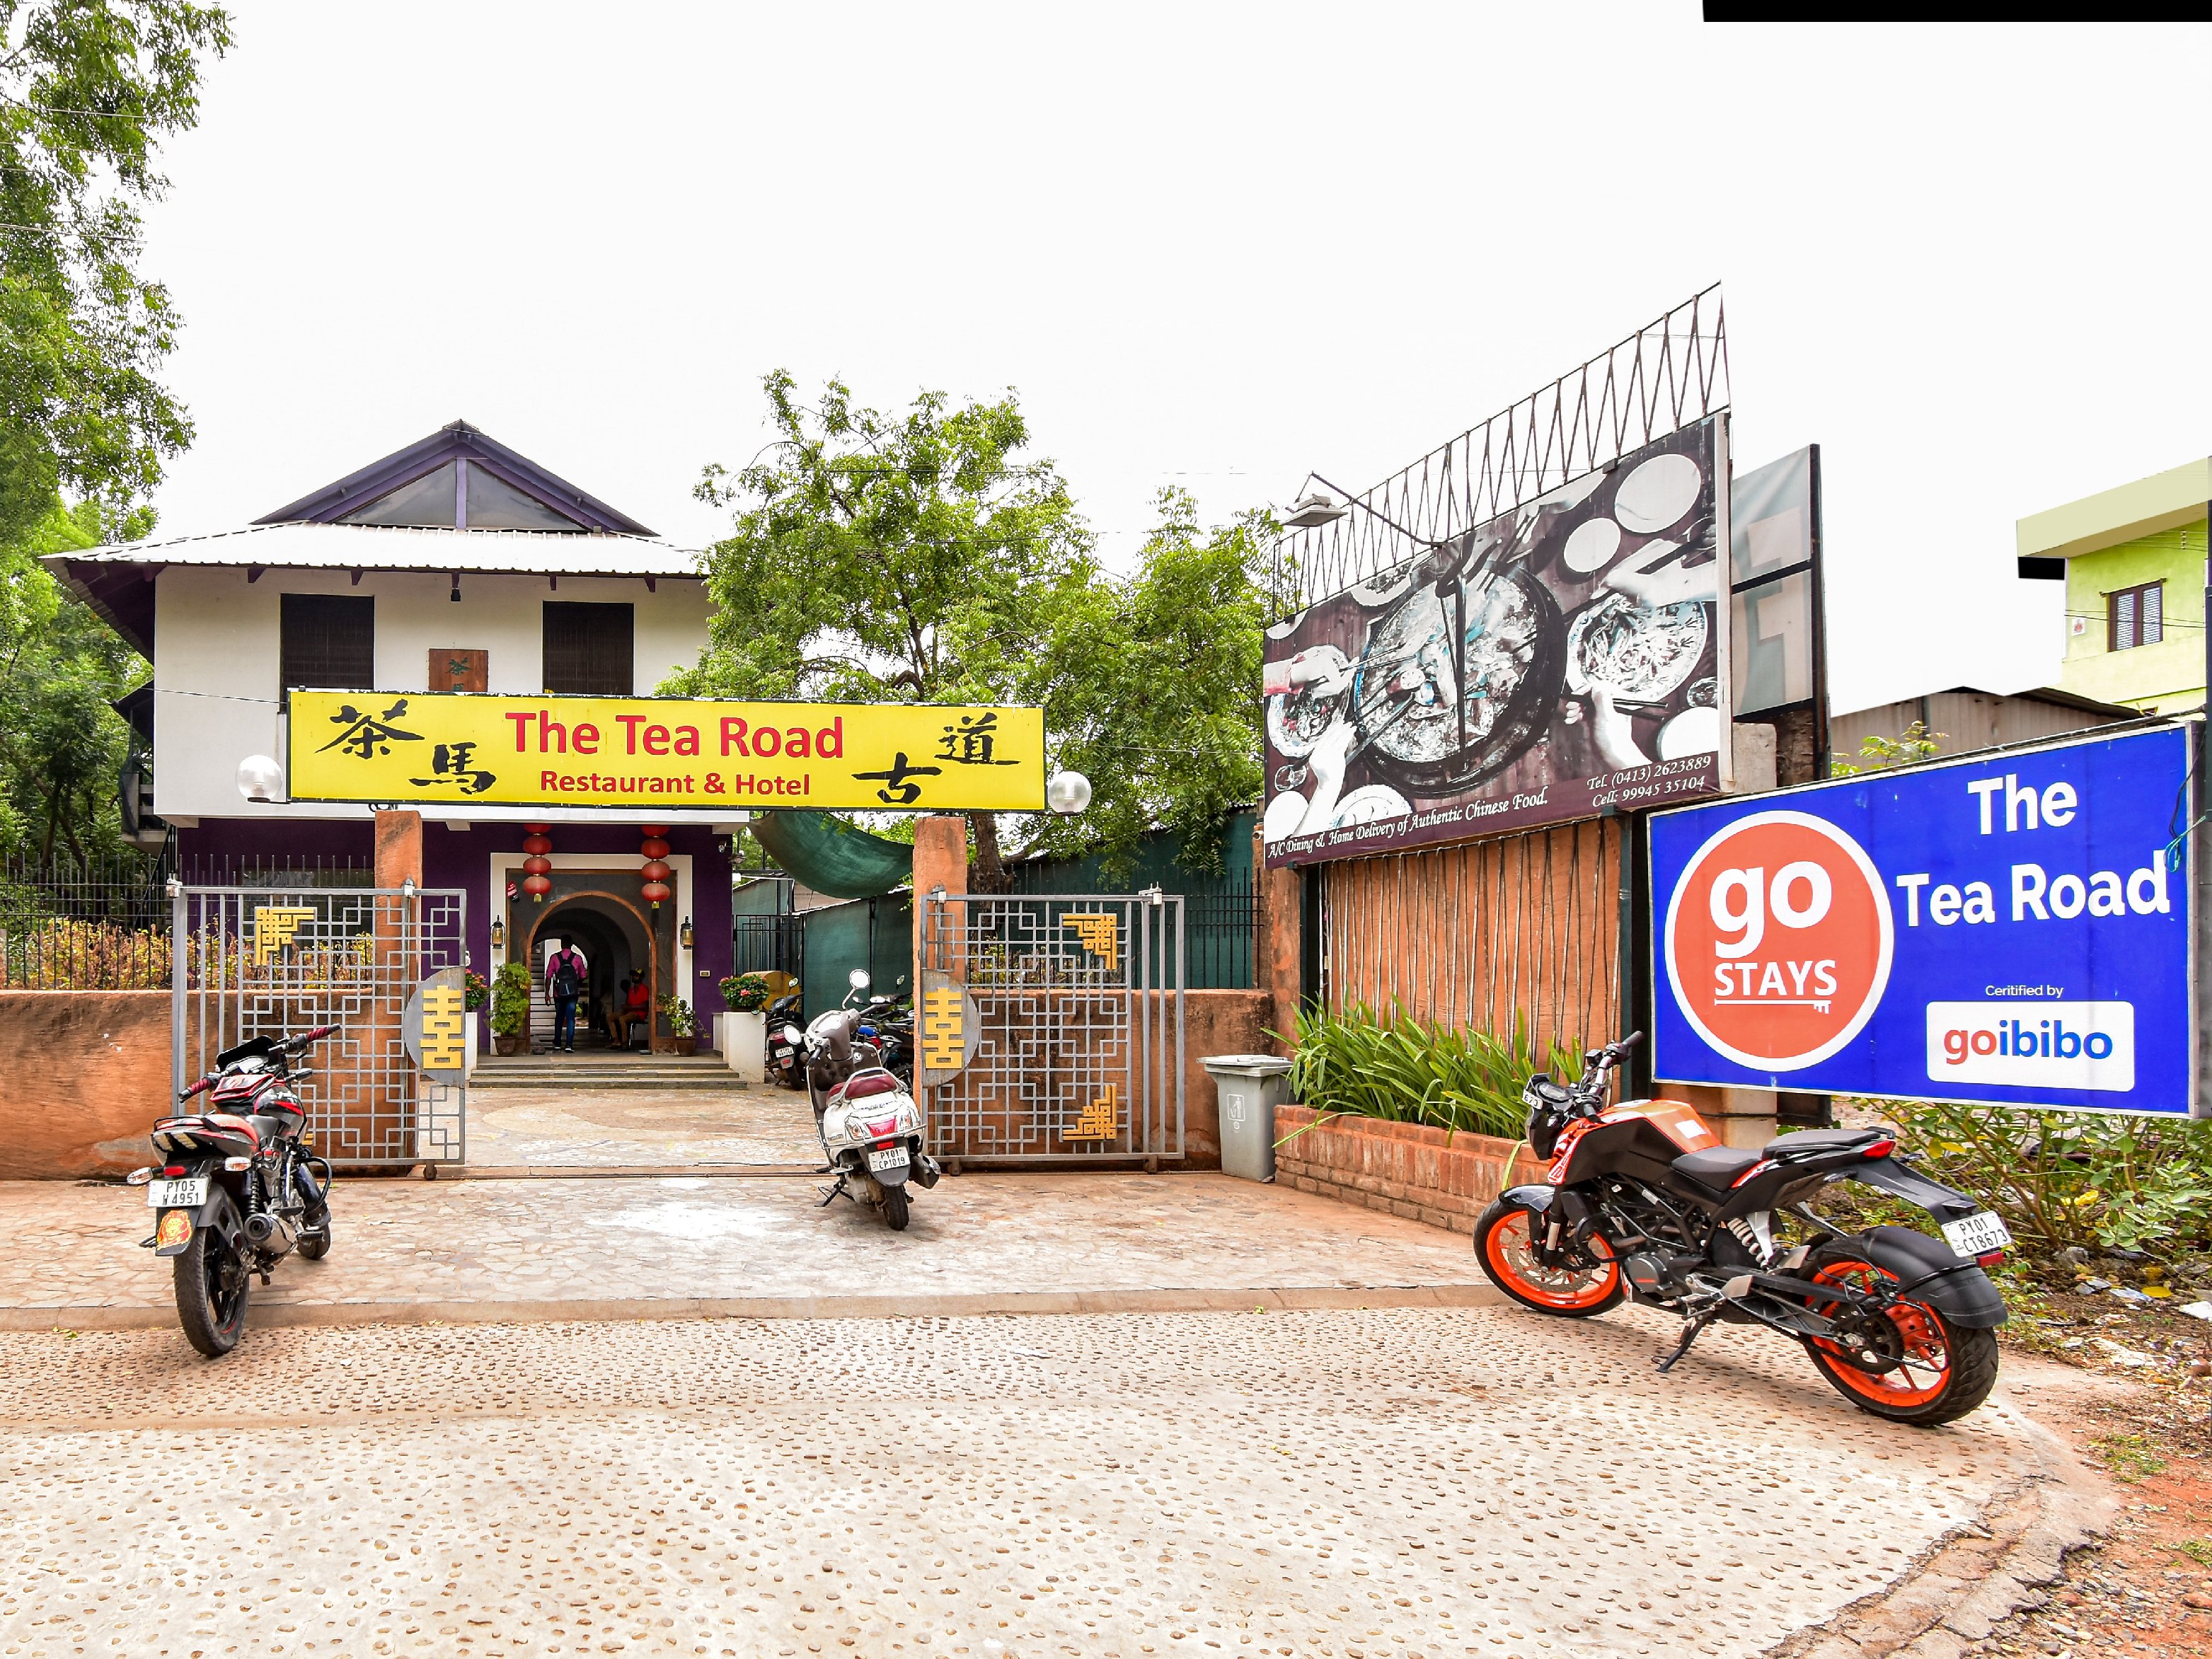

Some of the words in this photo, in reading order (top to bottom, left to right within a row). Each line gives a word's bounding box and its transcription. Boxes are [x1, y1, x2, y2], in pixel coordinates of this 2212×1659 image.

[505, 710, 599, 754] The
[616, 715, 699, 756] Tea
[720, 716, 843, 758] Road
[541, 770, 695, 793] Restaurant
[703, 773, 725, 794] &
[736, 774, 810, 795] Hotel
[1611, 766, 1651, 789] (0413)
[1654, 756, 1711, 778] 2623889
[1592, 790, 1618, 807] Cell:
[1622, 783, 1661, 801] 99945
[1664, 776, 1705, 793] 35104
[1967, 773, 2078, 836] The
[1268, 840, 1285, 859] A/C
[1286, 838, 1313, 853] Dining
[1315, 832, 1325, 847] &
[1328, 830, 1354, 845] Home
[1356, 821, 1395, 840] Delivery
[1398, 815, 1409, 836] of
[1409, 806, 1463, 831] Authentic
[1465, 799, 1509, 820] Chinese
[1512, 786, 1548, 810] Food.
[1896, 872, 1995, 927] Tea
[2011, 850, 2170, 921] Road
[1710, 860, 1832, 959] go
[1715, 959, 1837, 996] STAYS
[1986, 985, 2043, 996] Ceritified
[2047, 985, 2064, 998] by
[1944, 1020, 2112, 1065] goibibo
[879, 1157, 905, 1169] CP1019
[880, 1149, 899, 1160] PY01
[166, 1181, 196, 1193] PY05
[1959, 1217, 1988, 1235] PY01
[1963, 1229, 2007, 1252] CT8673
